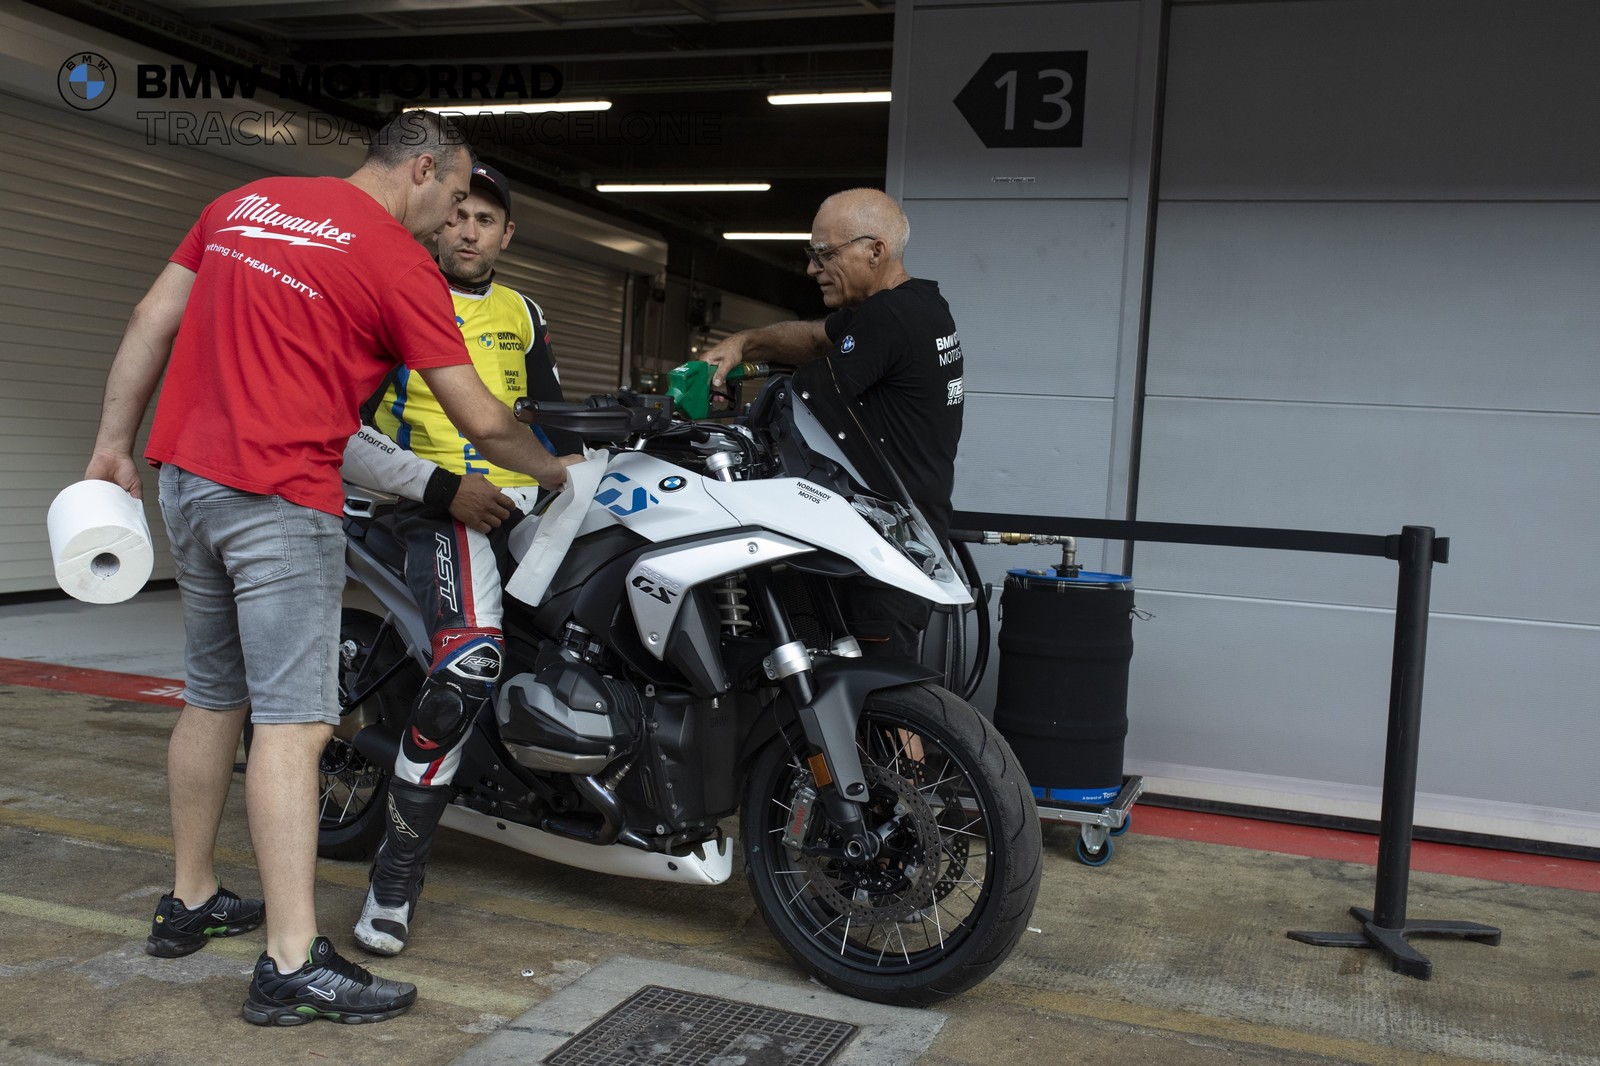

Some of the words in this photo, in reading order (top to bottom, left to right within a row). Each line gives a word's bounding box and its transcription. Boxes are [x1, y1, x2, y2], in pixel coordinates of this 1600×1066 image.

[994, 68, 1073, 131] 13
[244, 256, 281, 278] HEAVY
[497, 332, 516, 341] BMW
[504, 369, 519, 378] MAKE
[796, 481, 832, 501] NORMANDY
[798, 490, 821, 505] MOTOS
[435, 531, 459, 613] RST
[631, 575, 679, 605] GS
[460, 655, 500, 669] RST
